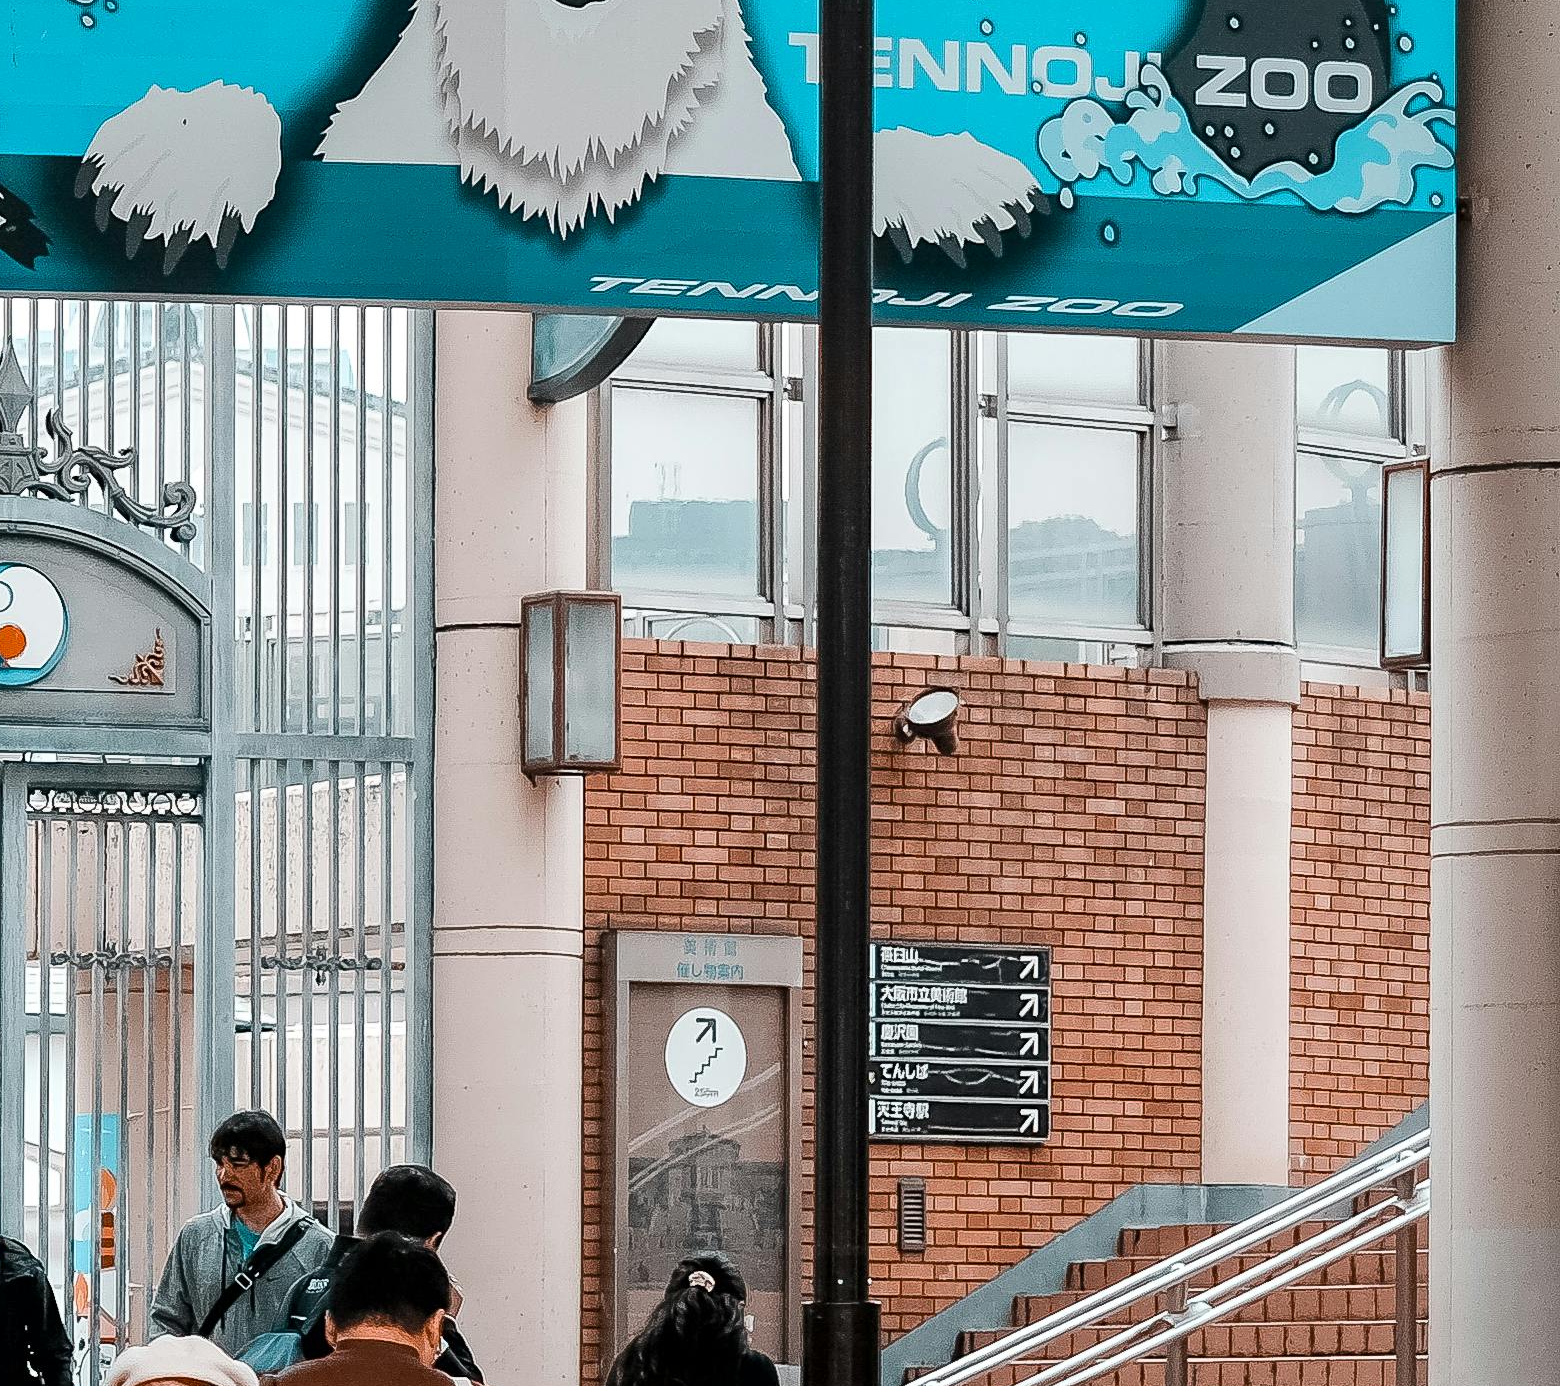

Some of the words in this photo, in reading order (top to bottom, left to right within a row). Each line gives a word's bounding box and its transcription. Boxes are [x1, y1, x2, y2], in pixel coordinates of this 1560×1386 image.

[788, 31, 1161, 102] TENNOJ
[1195, 54, 1372, 113] ZOO
[589, 276, 973, 308] TENNJI
[987, 296, 1185, 317] ZOO
